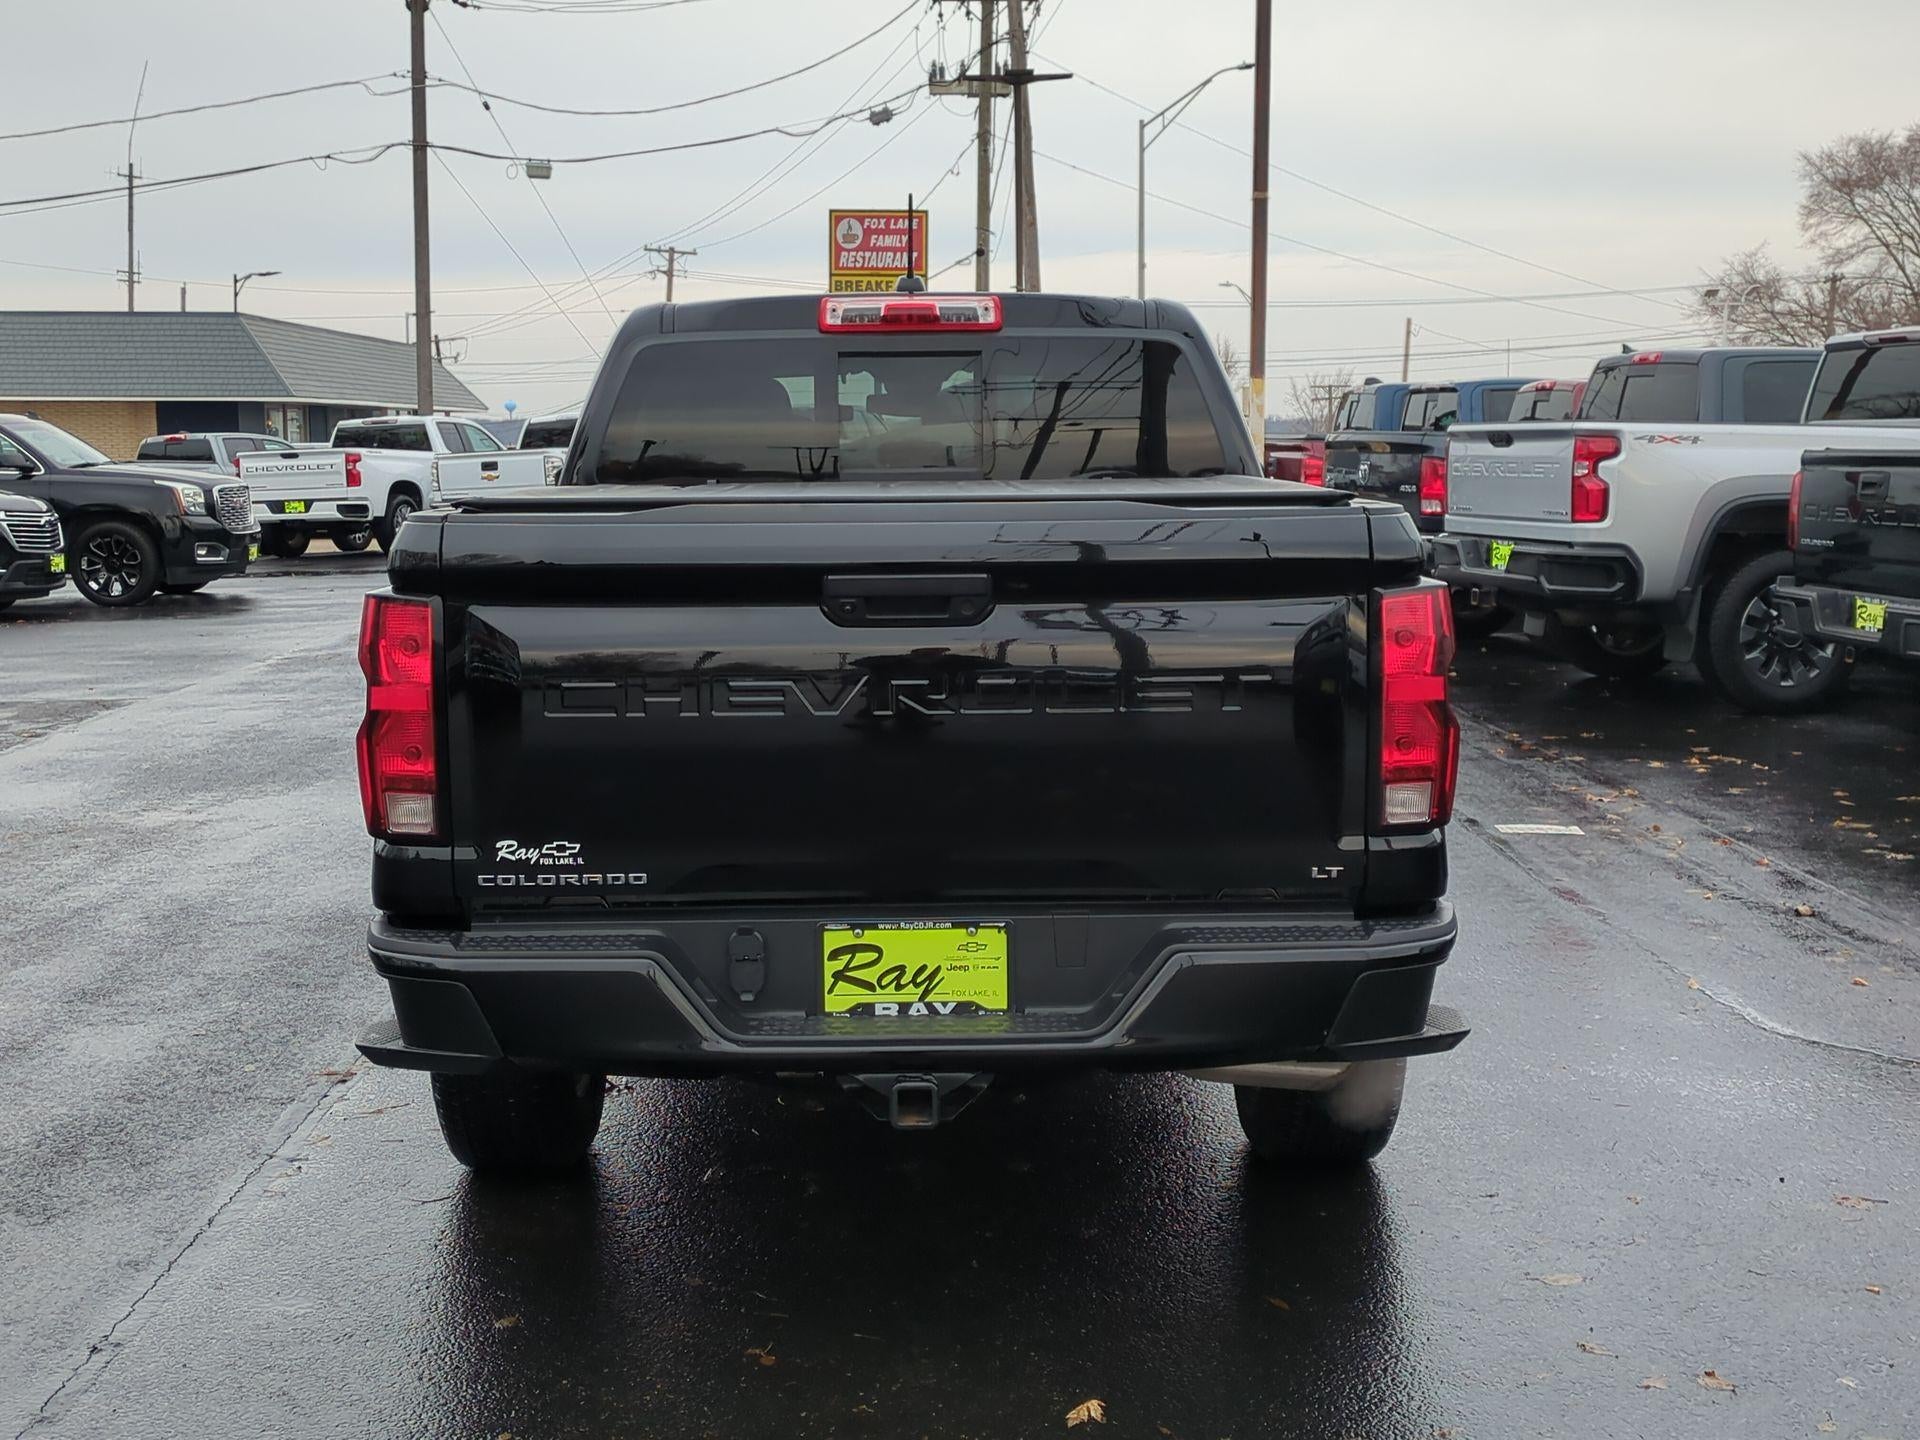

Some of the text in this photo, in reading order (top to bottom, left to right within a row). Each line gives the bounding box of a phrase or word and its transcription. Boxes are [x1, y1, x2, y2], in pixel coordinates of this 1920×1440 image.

[863, 218, 886, 229] FOX
[870, 235, 909, 247] FAMILY
[834, 280, 893, 292] BREAKF
[245, 463, 336, 473] CHEVROLET
[1451, 461, 1561, 478] CHEVROLET
[544, 674, 1274, 716] CHEVROLET
[496, 840, 541, 864] Ray
[540, 857, 554, 865] FOX
[555, 857, 576, 866] LAKE,
[1311, 866, 1345, 878] LT
[477, 873, 648, 886] COLORADO
[826, 943, 946, 1002] Ray
[946, 963, 970, 973] Jeep
[951, 989, 967, 997] FOX
